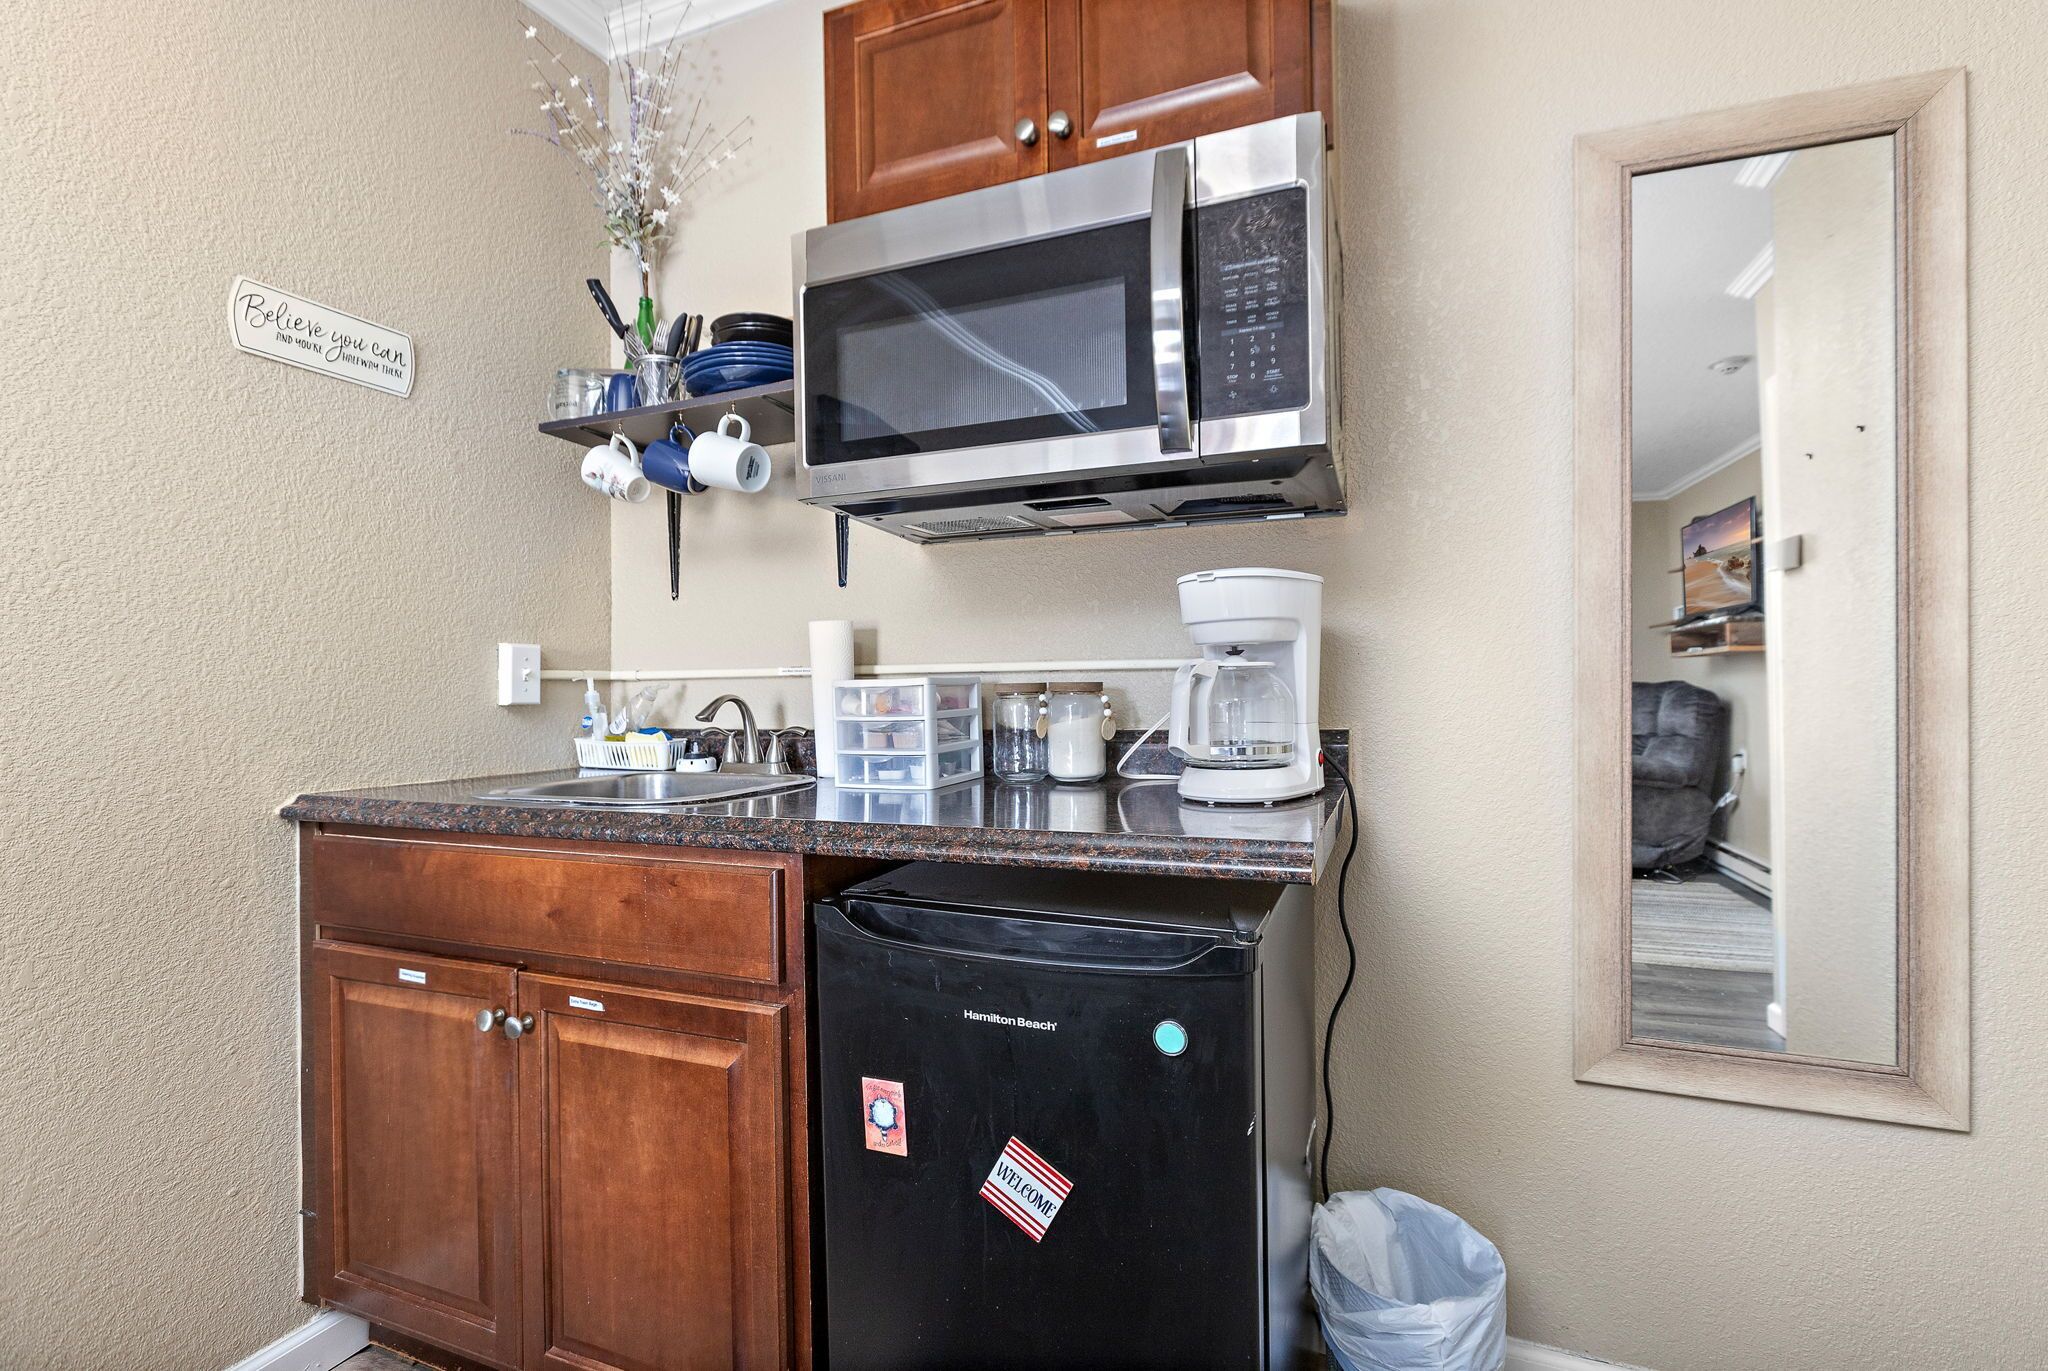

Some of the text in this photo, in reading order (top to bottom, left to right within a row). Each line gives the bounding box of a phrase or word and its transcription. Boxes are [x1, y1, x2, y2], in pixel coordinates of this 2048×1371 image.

[239, 294, 407, 368] Believe you can
[276, 332, 294, 345] AND
[342, 352, 379, 373] HALFWAY
[382, 364, 404, 379] THERE
[815, 473, 847, 484] VISSANI
[963, 1009, 1057, 1031] Hamilton Beach
[996, 1161, 1057, 1219] WELCOME
